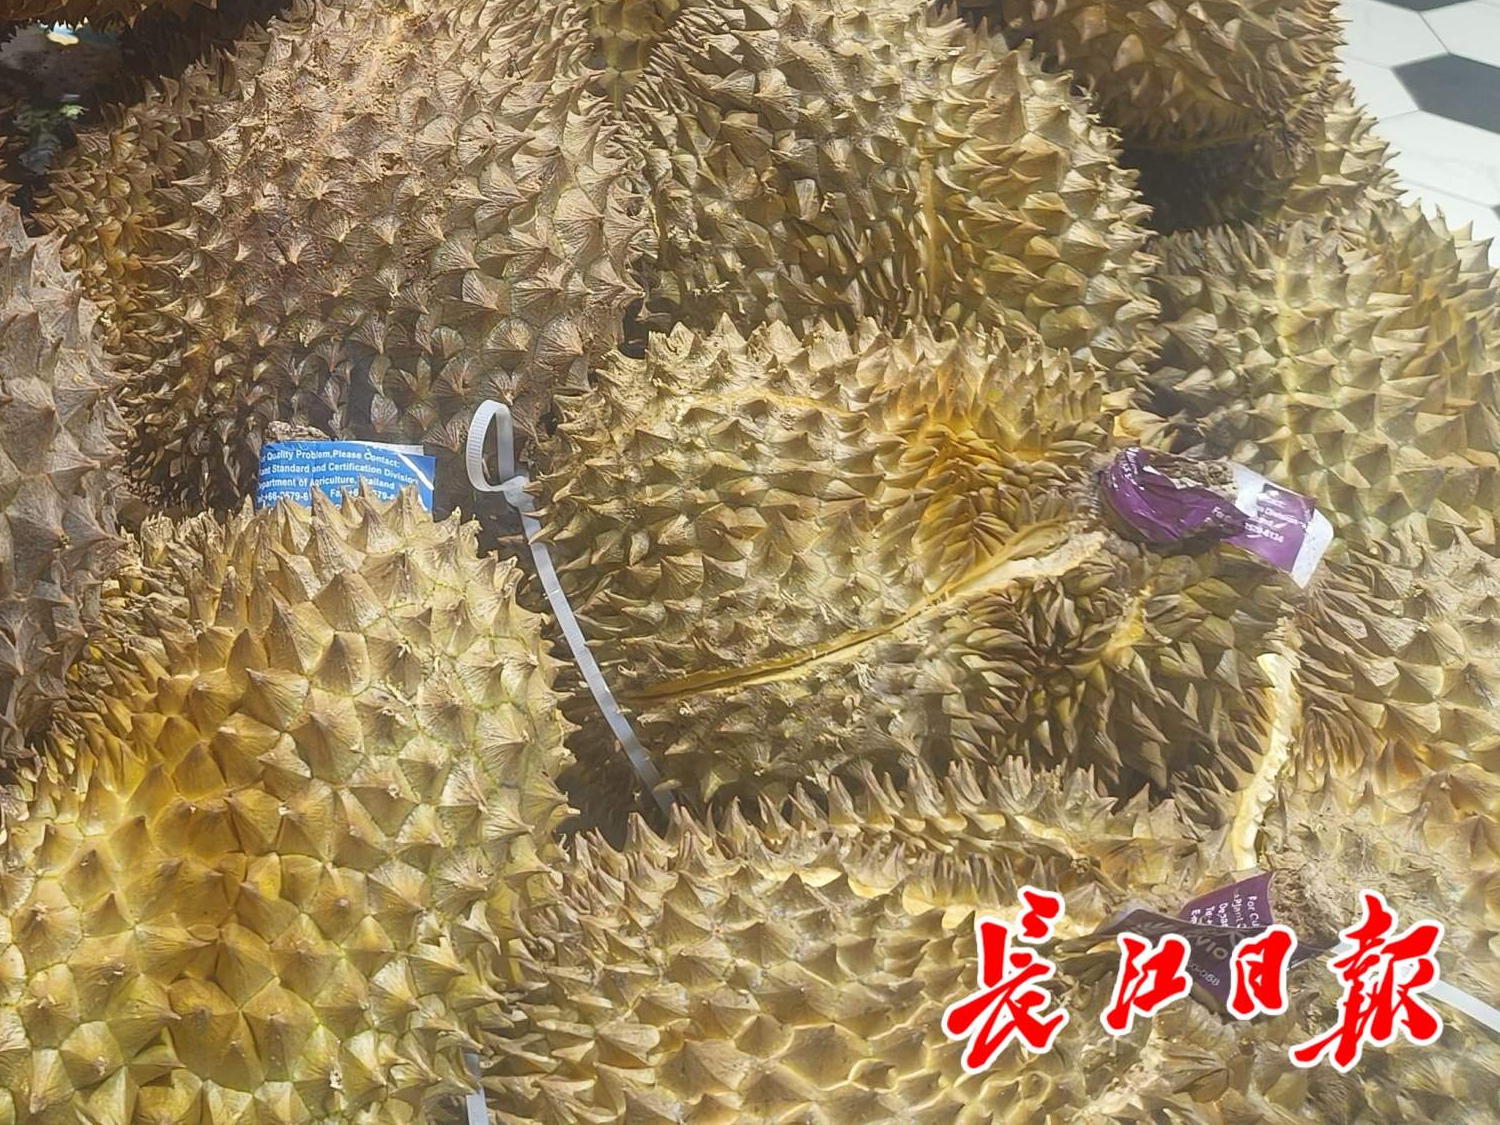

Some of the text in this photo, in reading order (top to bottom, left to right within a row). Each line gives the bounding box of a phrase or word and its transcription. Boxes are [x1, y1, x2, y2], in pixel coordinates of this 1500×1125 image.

[266, 449, 294, 461] Quality
[272, 464, 310, 473] Standard
[312, 463, 326, 472] and
[328, 462, 382, 475] Certification
[298, 477, 308, 486] of
